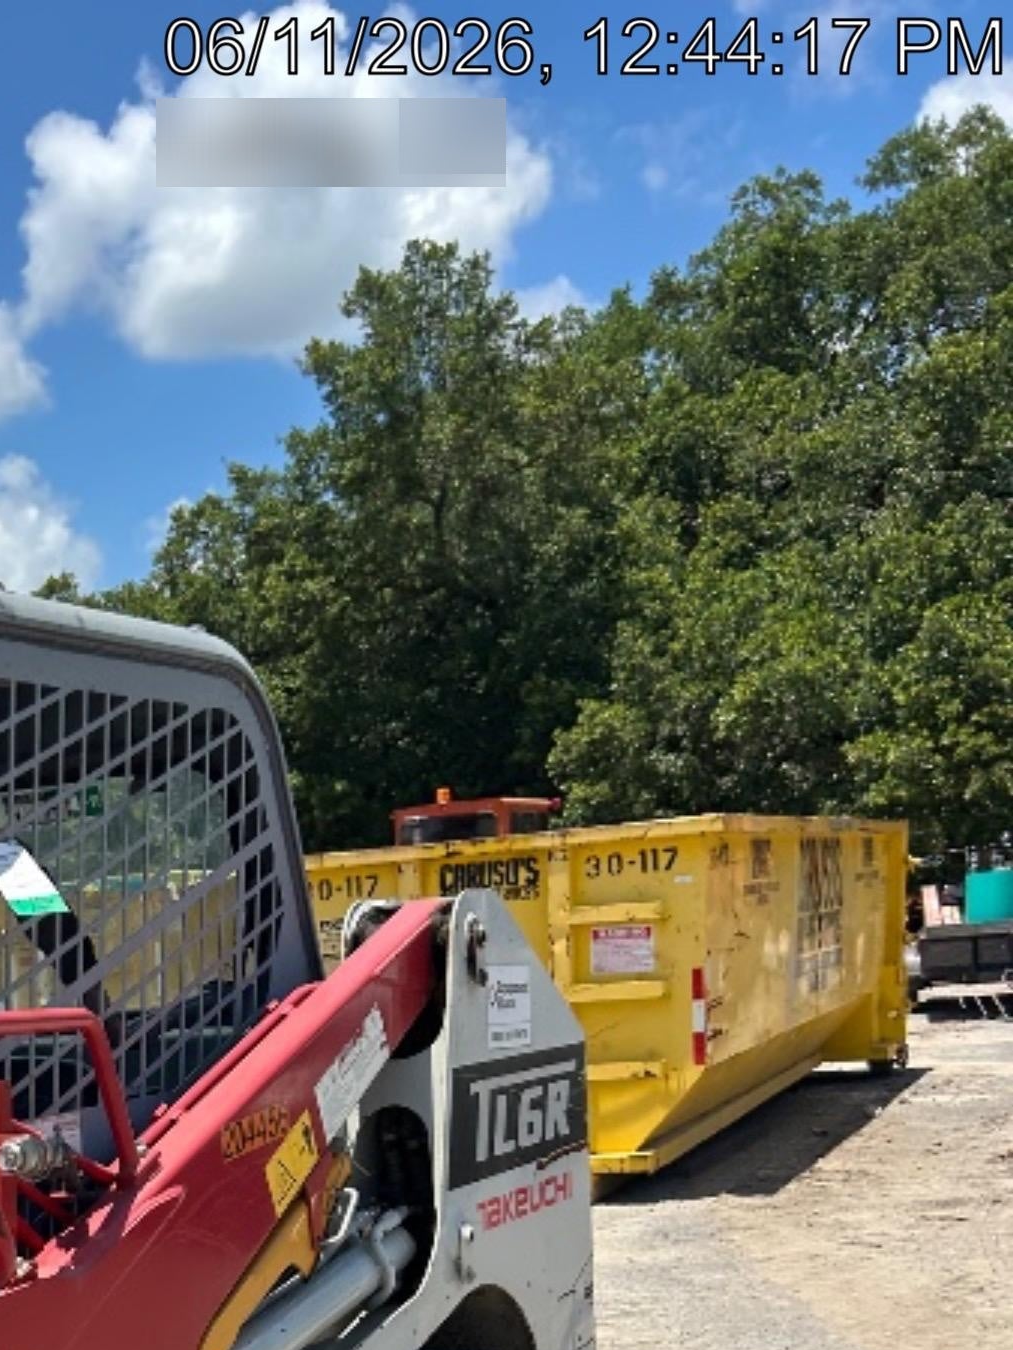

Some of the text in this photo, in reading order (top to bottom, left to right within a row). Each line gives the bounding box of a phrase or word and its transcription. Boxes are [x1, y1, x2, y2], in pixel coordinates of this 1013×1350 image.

[439, 856, 540, 898] CARUSO'S
[585, 847, 678, 879] 30-117
[307, 874, 378, 901] 0-117
[469, 1058, 577, 1163] TL6R
[476, 1171, 573, 1232] TAKEUCHI
